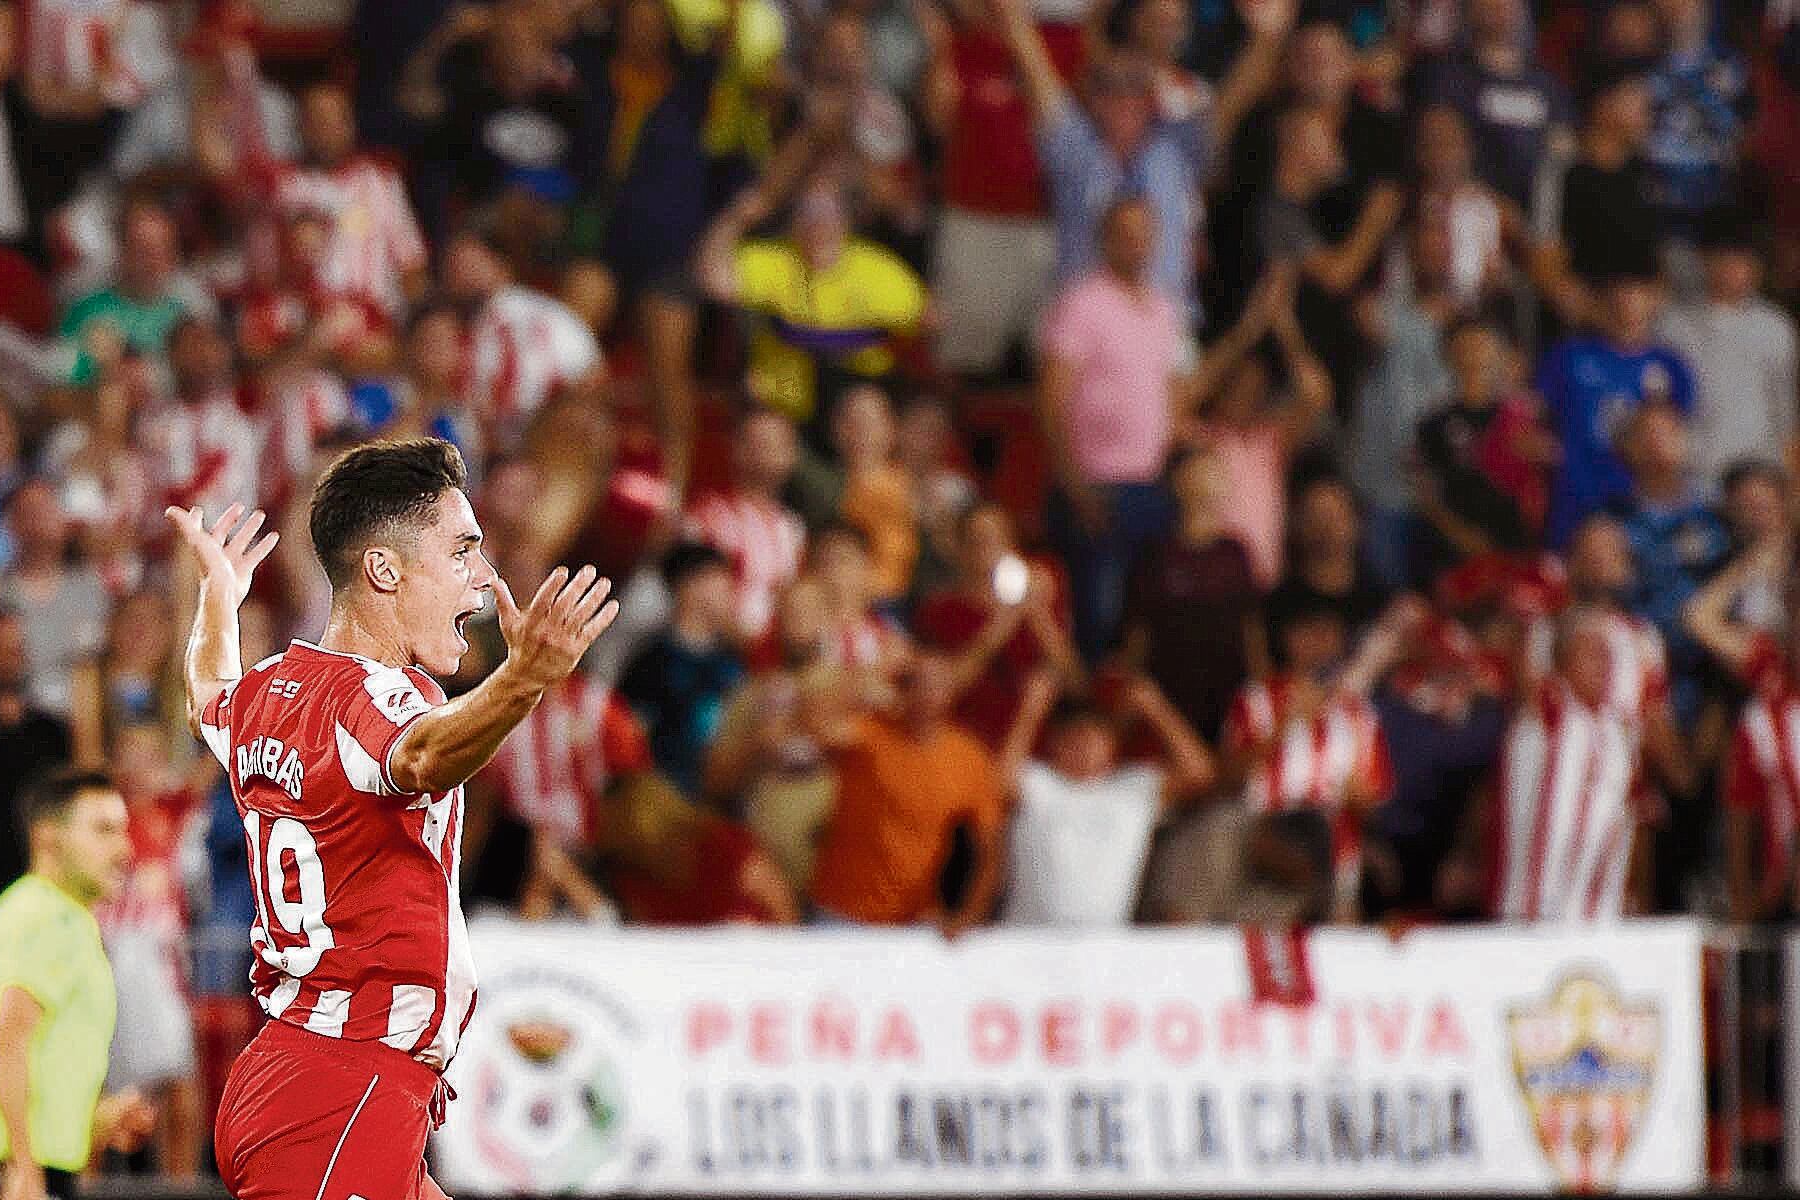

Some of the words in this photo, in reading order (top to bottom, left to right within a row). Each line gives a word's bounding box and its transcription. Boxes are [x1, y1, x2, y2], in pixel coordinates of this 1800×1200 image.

[687, 988, 920, 1064] PEÑA
[969, 1001, 1470, 1065] DEPORTIVA
[686, 1084, 806, 1172] LOS
[814, 1083, 1042, 1172] LLANOS
[1064, 1083, 1128, 1170] DE
[1147, 1085, 1226, 1168] LA
[1244, 1062, 1480, 1168] CAÑADA
